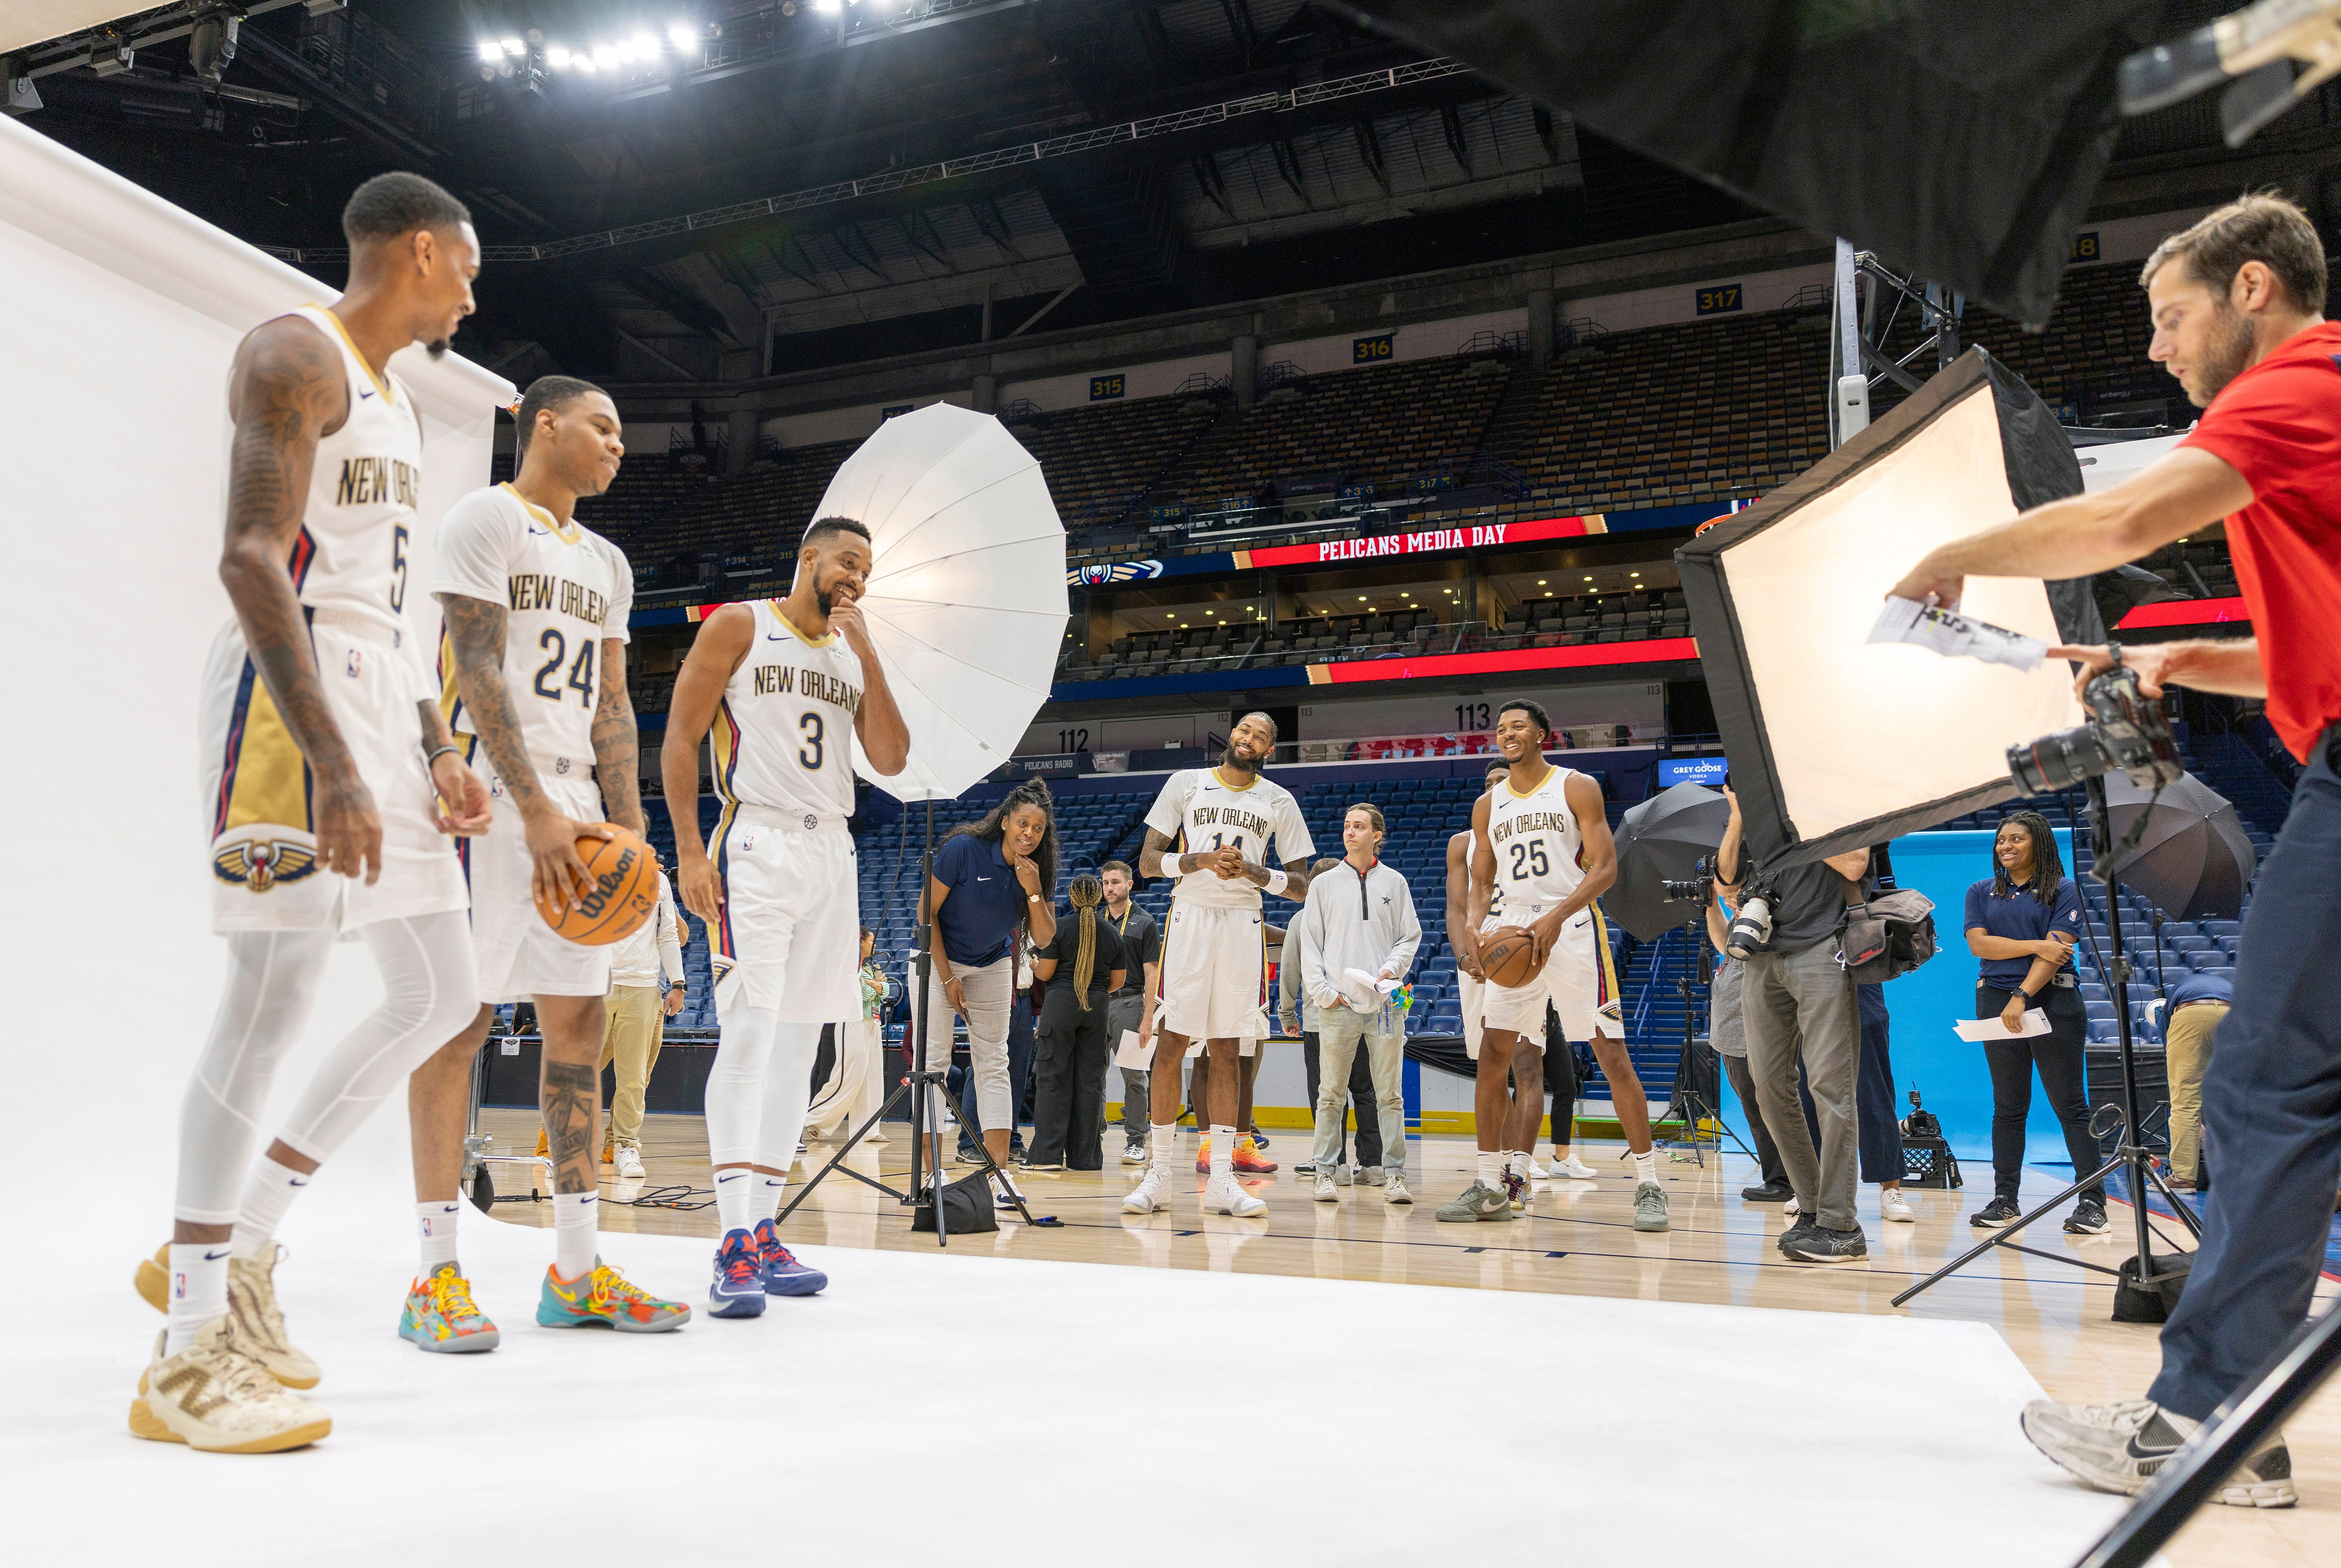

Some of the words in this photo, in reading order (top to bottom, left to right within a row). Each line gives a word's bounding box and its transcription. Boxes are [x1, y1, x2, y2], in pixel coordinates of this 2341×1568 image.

[1701, 289, 1738, 309] 317
[1357, 340, 1389, 358] 316
[1092, 380, 1121, 395] 315
[337, 456, 388, 507] NEW
[1354, 486, 1373, 495] 36
[1419, 478, 1437, 488] 317
[1163, 508, 1180, 517] 315
[1222, 502, 1239, 510] 316
[1319, 535, 1400, 561] PELICANS
[1407, 528, 1464, 552] MEDIA
[1473, 524, 1507, 547] DAY
[732, 556, 746, 564] 314
[780, 551, 793, 559] 315
[390, 522, 410, 615] 5
[634, 568, 647, 576] 314
[508, 574, 556, 611] NEW
[533, 627, 595, 710] 24
[754, 665, 795, 697] NEW
[1647, 685, 1660, 695] 113
[1217, 713, 1229, 722] 112
[1301, 708, 1312, 717] 113
[1455, 703, 1491, 730] 113
[798, 710, 824, 772] 3
[1059, 728, 1089, 753] 112
[1025, 761, 1053, 770] PELICANS
[1055, 759, 1073, 768] RADIO
[1194, 807, 1219, 827] NEW
[1223, 808, 1267, 839] ORLEANS
[1493, 818, 1513, 845] NEW
[1517, 812, 1564, 833] ORLEANS
[1510, 838, 1549, 881] 25
[575, 847, 637, 919] Wilson
